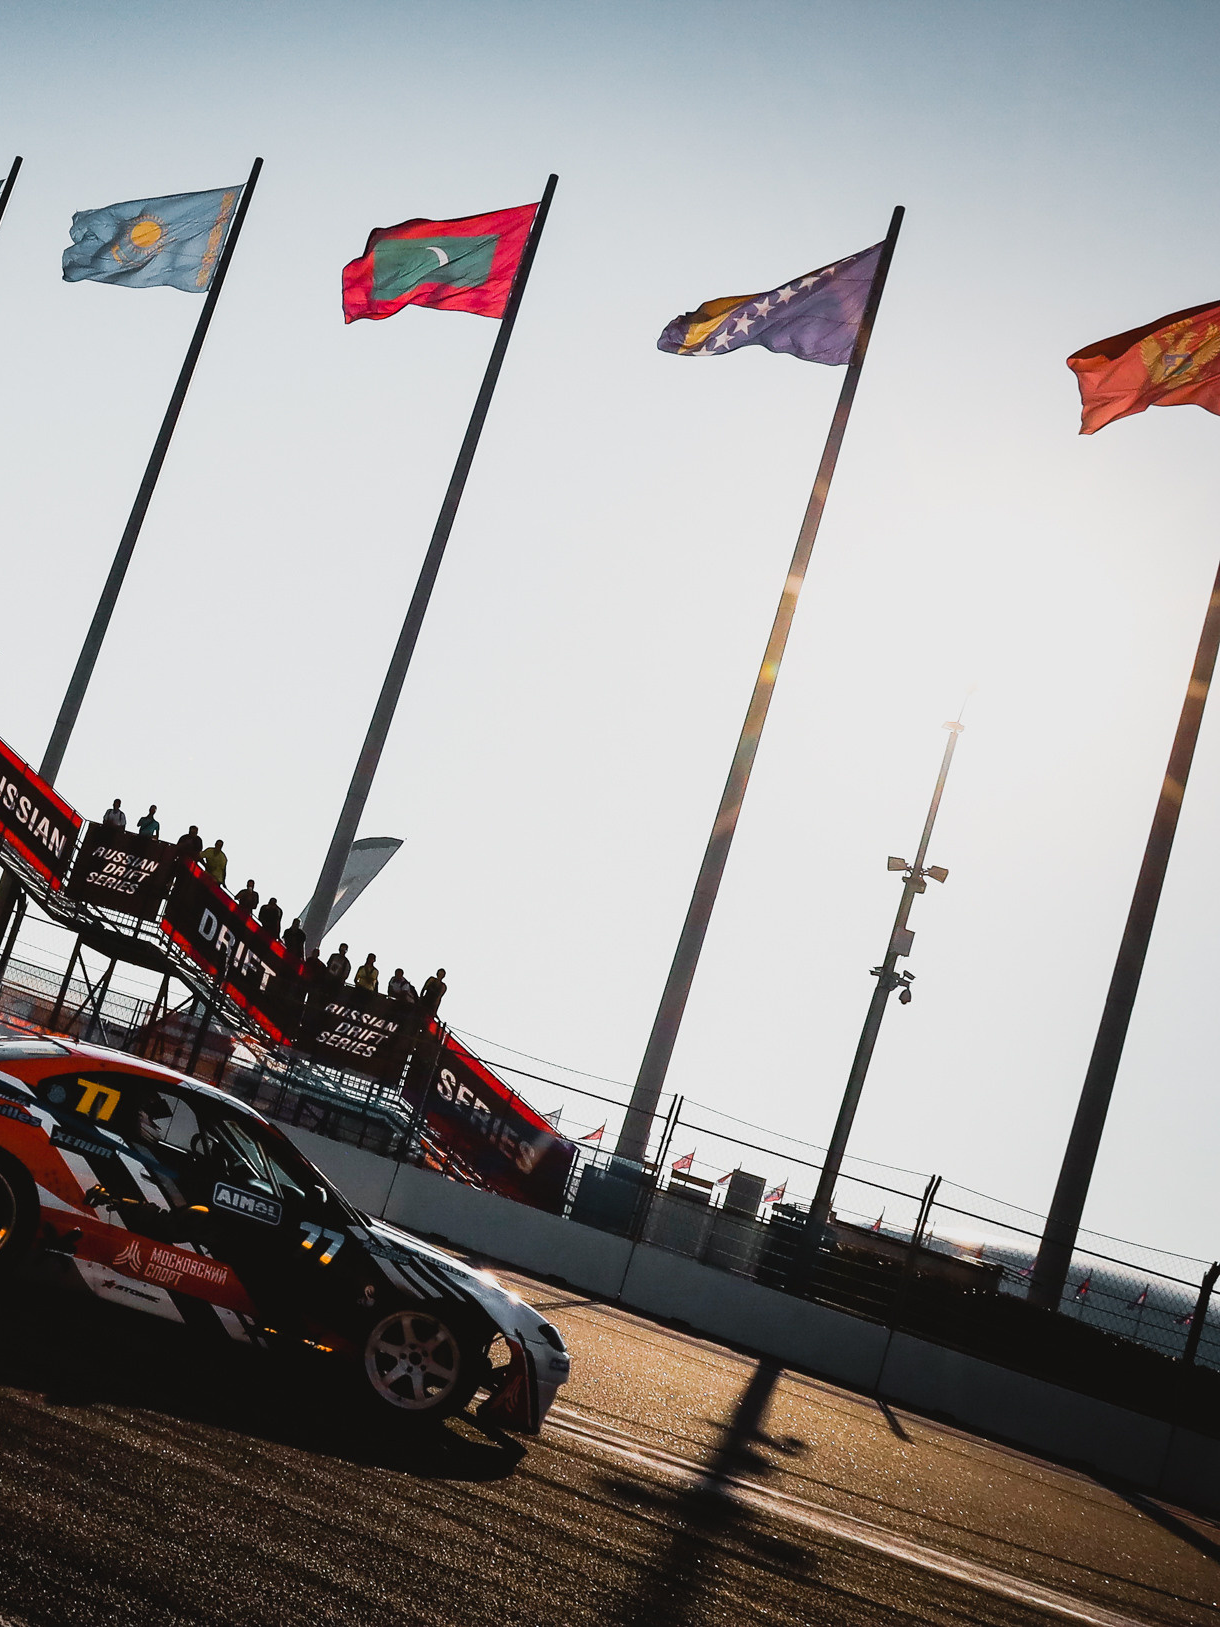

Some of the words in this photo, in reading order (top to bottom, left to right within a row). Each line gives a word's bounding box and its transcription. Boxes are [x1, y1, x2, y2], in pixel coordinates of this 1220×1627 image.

[92, 846, 159, 873] RUSSIAN
[102, 863, 150, 885] DRIFT
[86, 871, 139, 895] SERIES
[198, 907, 278, 993] DRIFT
[326, 1003, 399, 1034] RUSSIAN
[335, 1021, 389, 1045] DRIFT
[316, 1031, 378, 1058] SERIES
[75, 1077, 121, 1121] 77
[436, 1067, 537, 1175] SERIES
[216, 1188, 278, 1219] AIMOL
[299, 1220, 345, 1266] 77
[144, 1263, 183, 1287] СПОРТ
[150, 1247, 228, 1286] МОСКОВСКИЙ
